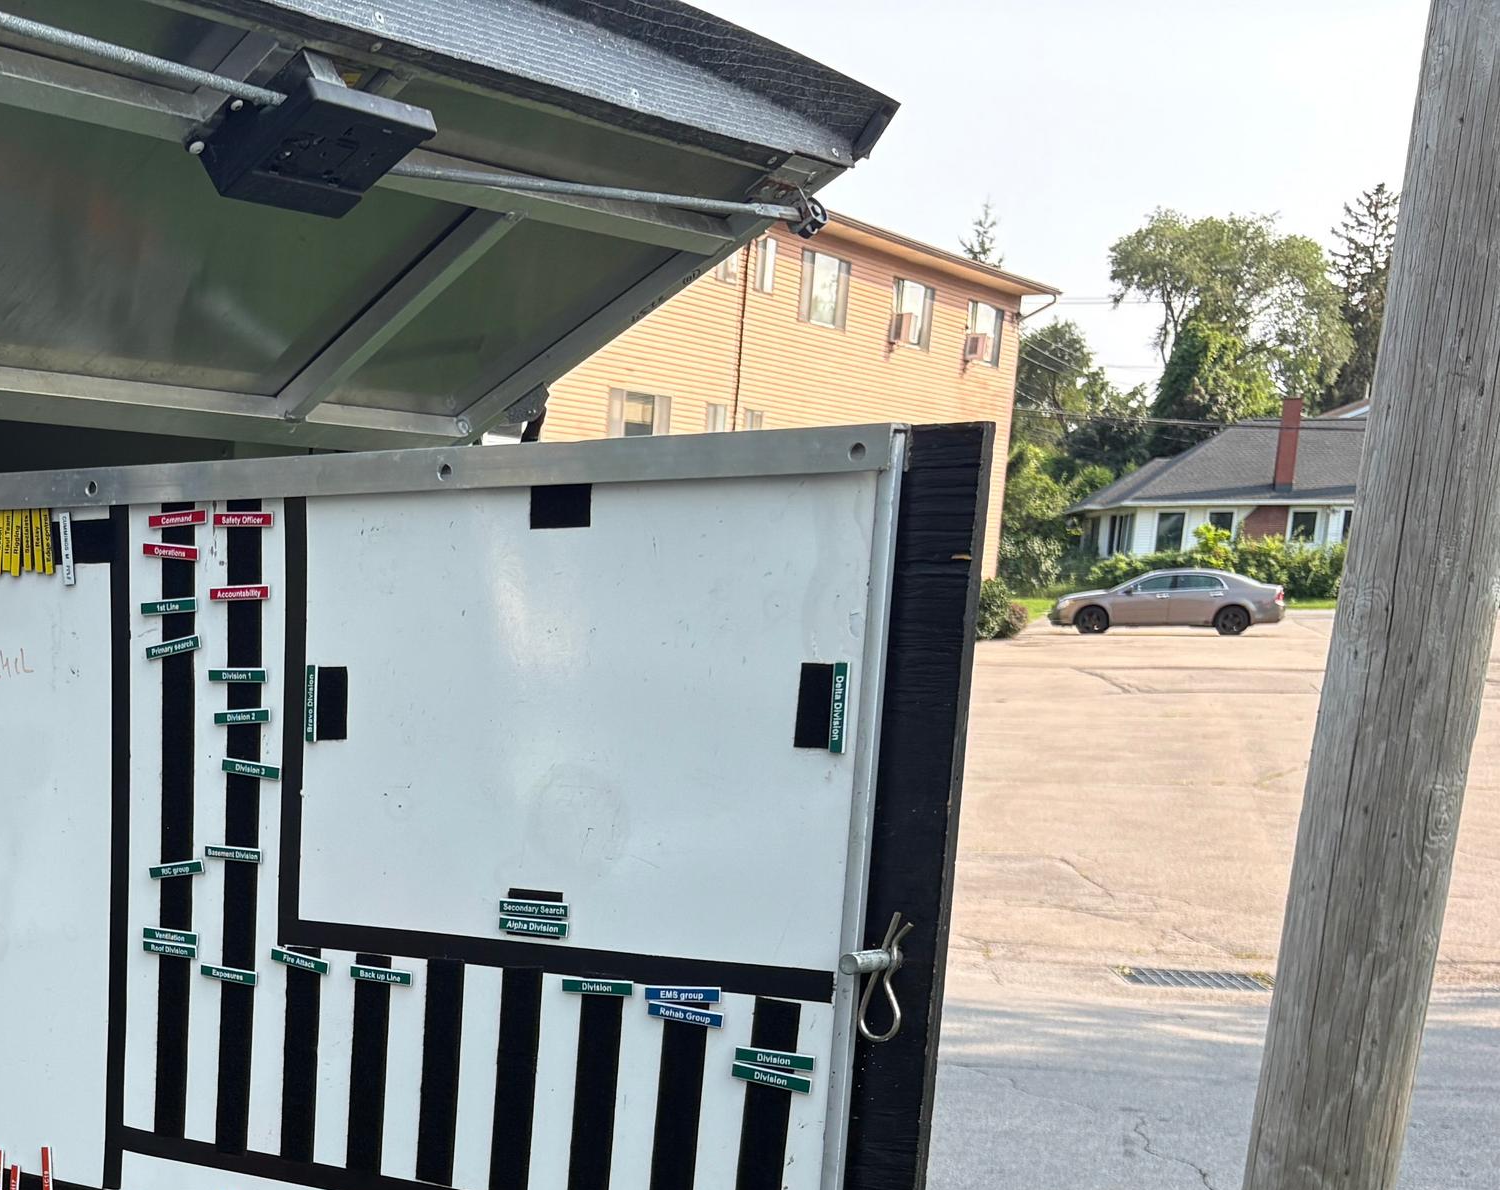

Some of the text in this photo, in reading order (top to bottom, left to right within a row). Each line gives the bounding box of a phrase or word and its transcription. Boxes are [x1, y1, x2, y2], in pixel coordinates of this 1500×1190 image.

[161, 514, 192, 525] Command
[222, 516, 264, 526] Safety Officer
[154, 547, 186, 558] Operations
[217, 589, 261, 598] Accountability
[156, 603, 180, 611] 1st Line
[151, 640, 194, 656] Primary search
[222, 672, 252, 680] Division 1
[832, 676, 844, 740] Delta Division
[226, 714, 250, 722] Division
[235, 764, 260, 774] Division
[207, 848, 258, 861] Basement Division
[162, 866, 190, 876] RIC group
[503, 902, 564, 916] Secondary Search
[506, 920, 558, 934] Alpha Division
[155, 931, 185, 942] Ventilation
[151, 944, 188, 956] Roof Division
[282, 954, 316, 970] Fire Attack
[212, 968, 244, 982] Exposures
[359, 970, 401, 982] Back up Line
[582, 982, 612, 993] Division
[660, 990, 704, 1002] EMS group
[659, 1007, 711, 1025] Rehab Group
[756, 1054, 791, 1066] Division
[754, 1071, 788, 1086] Division
